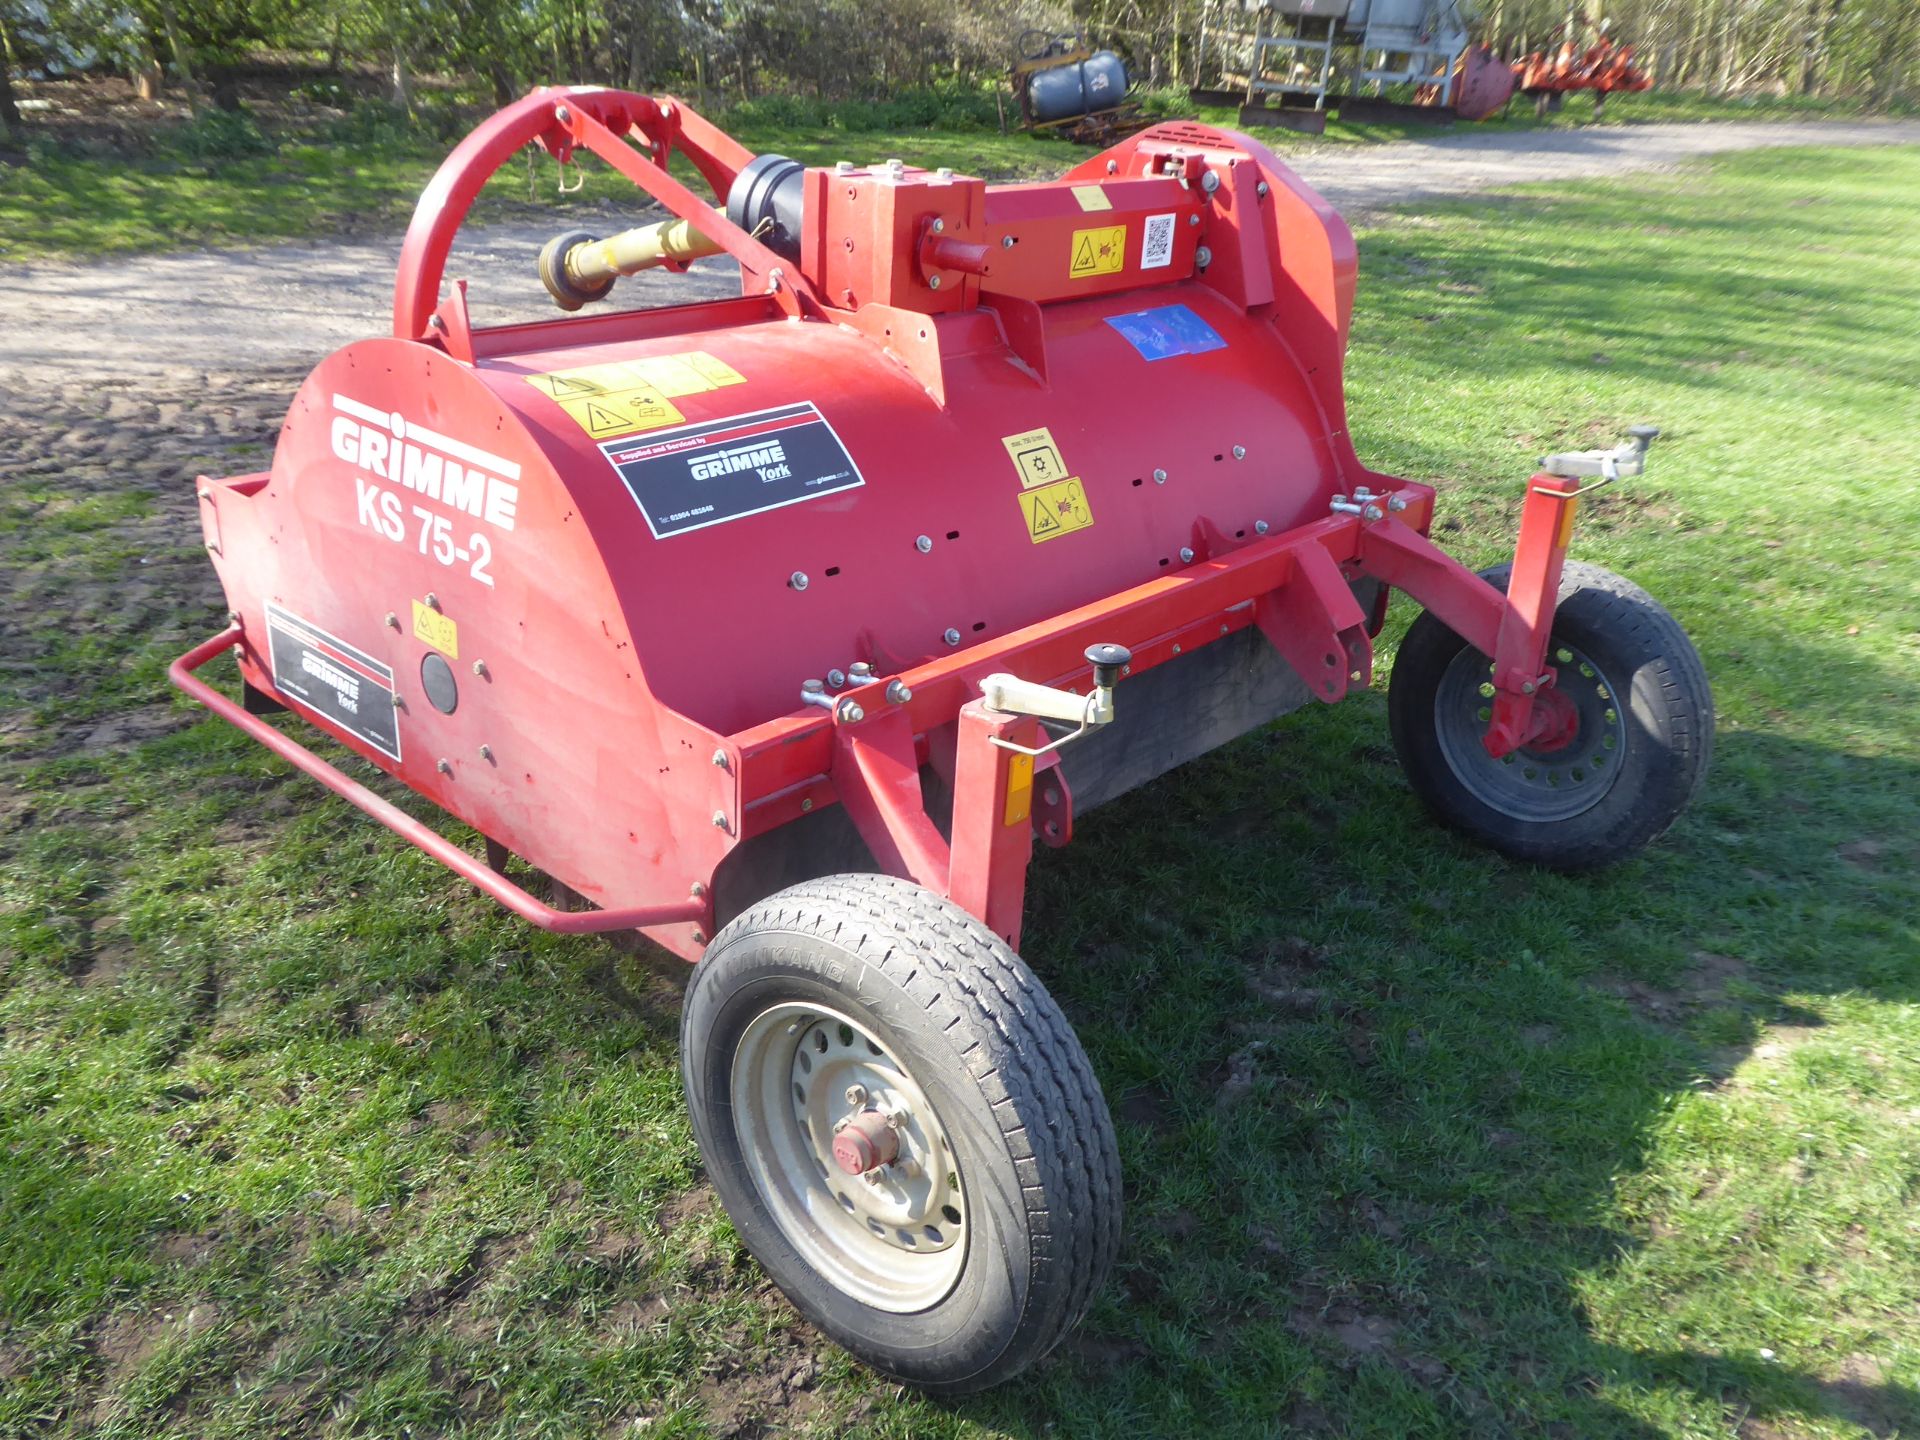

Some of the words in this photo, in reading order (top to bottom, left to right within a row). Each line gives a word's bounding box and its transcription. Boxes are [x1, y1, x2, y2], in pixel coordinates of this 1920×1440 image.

[619, 448, 653, 461] Supplied
[652, 445, 667, 454] and
[665, 439, 697, 451] Serviced
[696, 437, 707, 445] by
[690, 445, 786, 481] GRIMME
[331, 411, 519, 531] GRIMME
[756, 463, 792, 482] York
[356, 478, 405, 543] KS
[413, 505, 495, 588] 75-2
[337, 691, 359, 715] York
